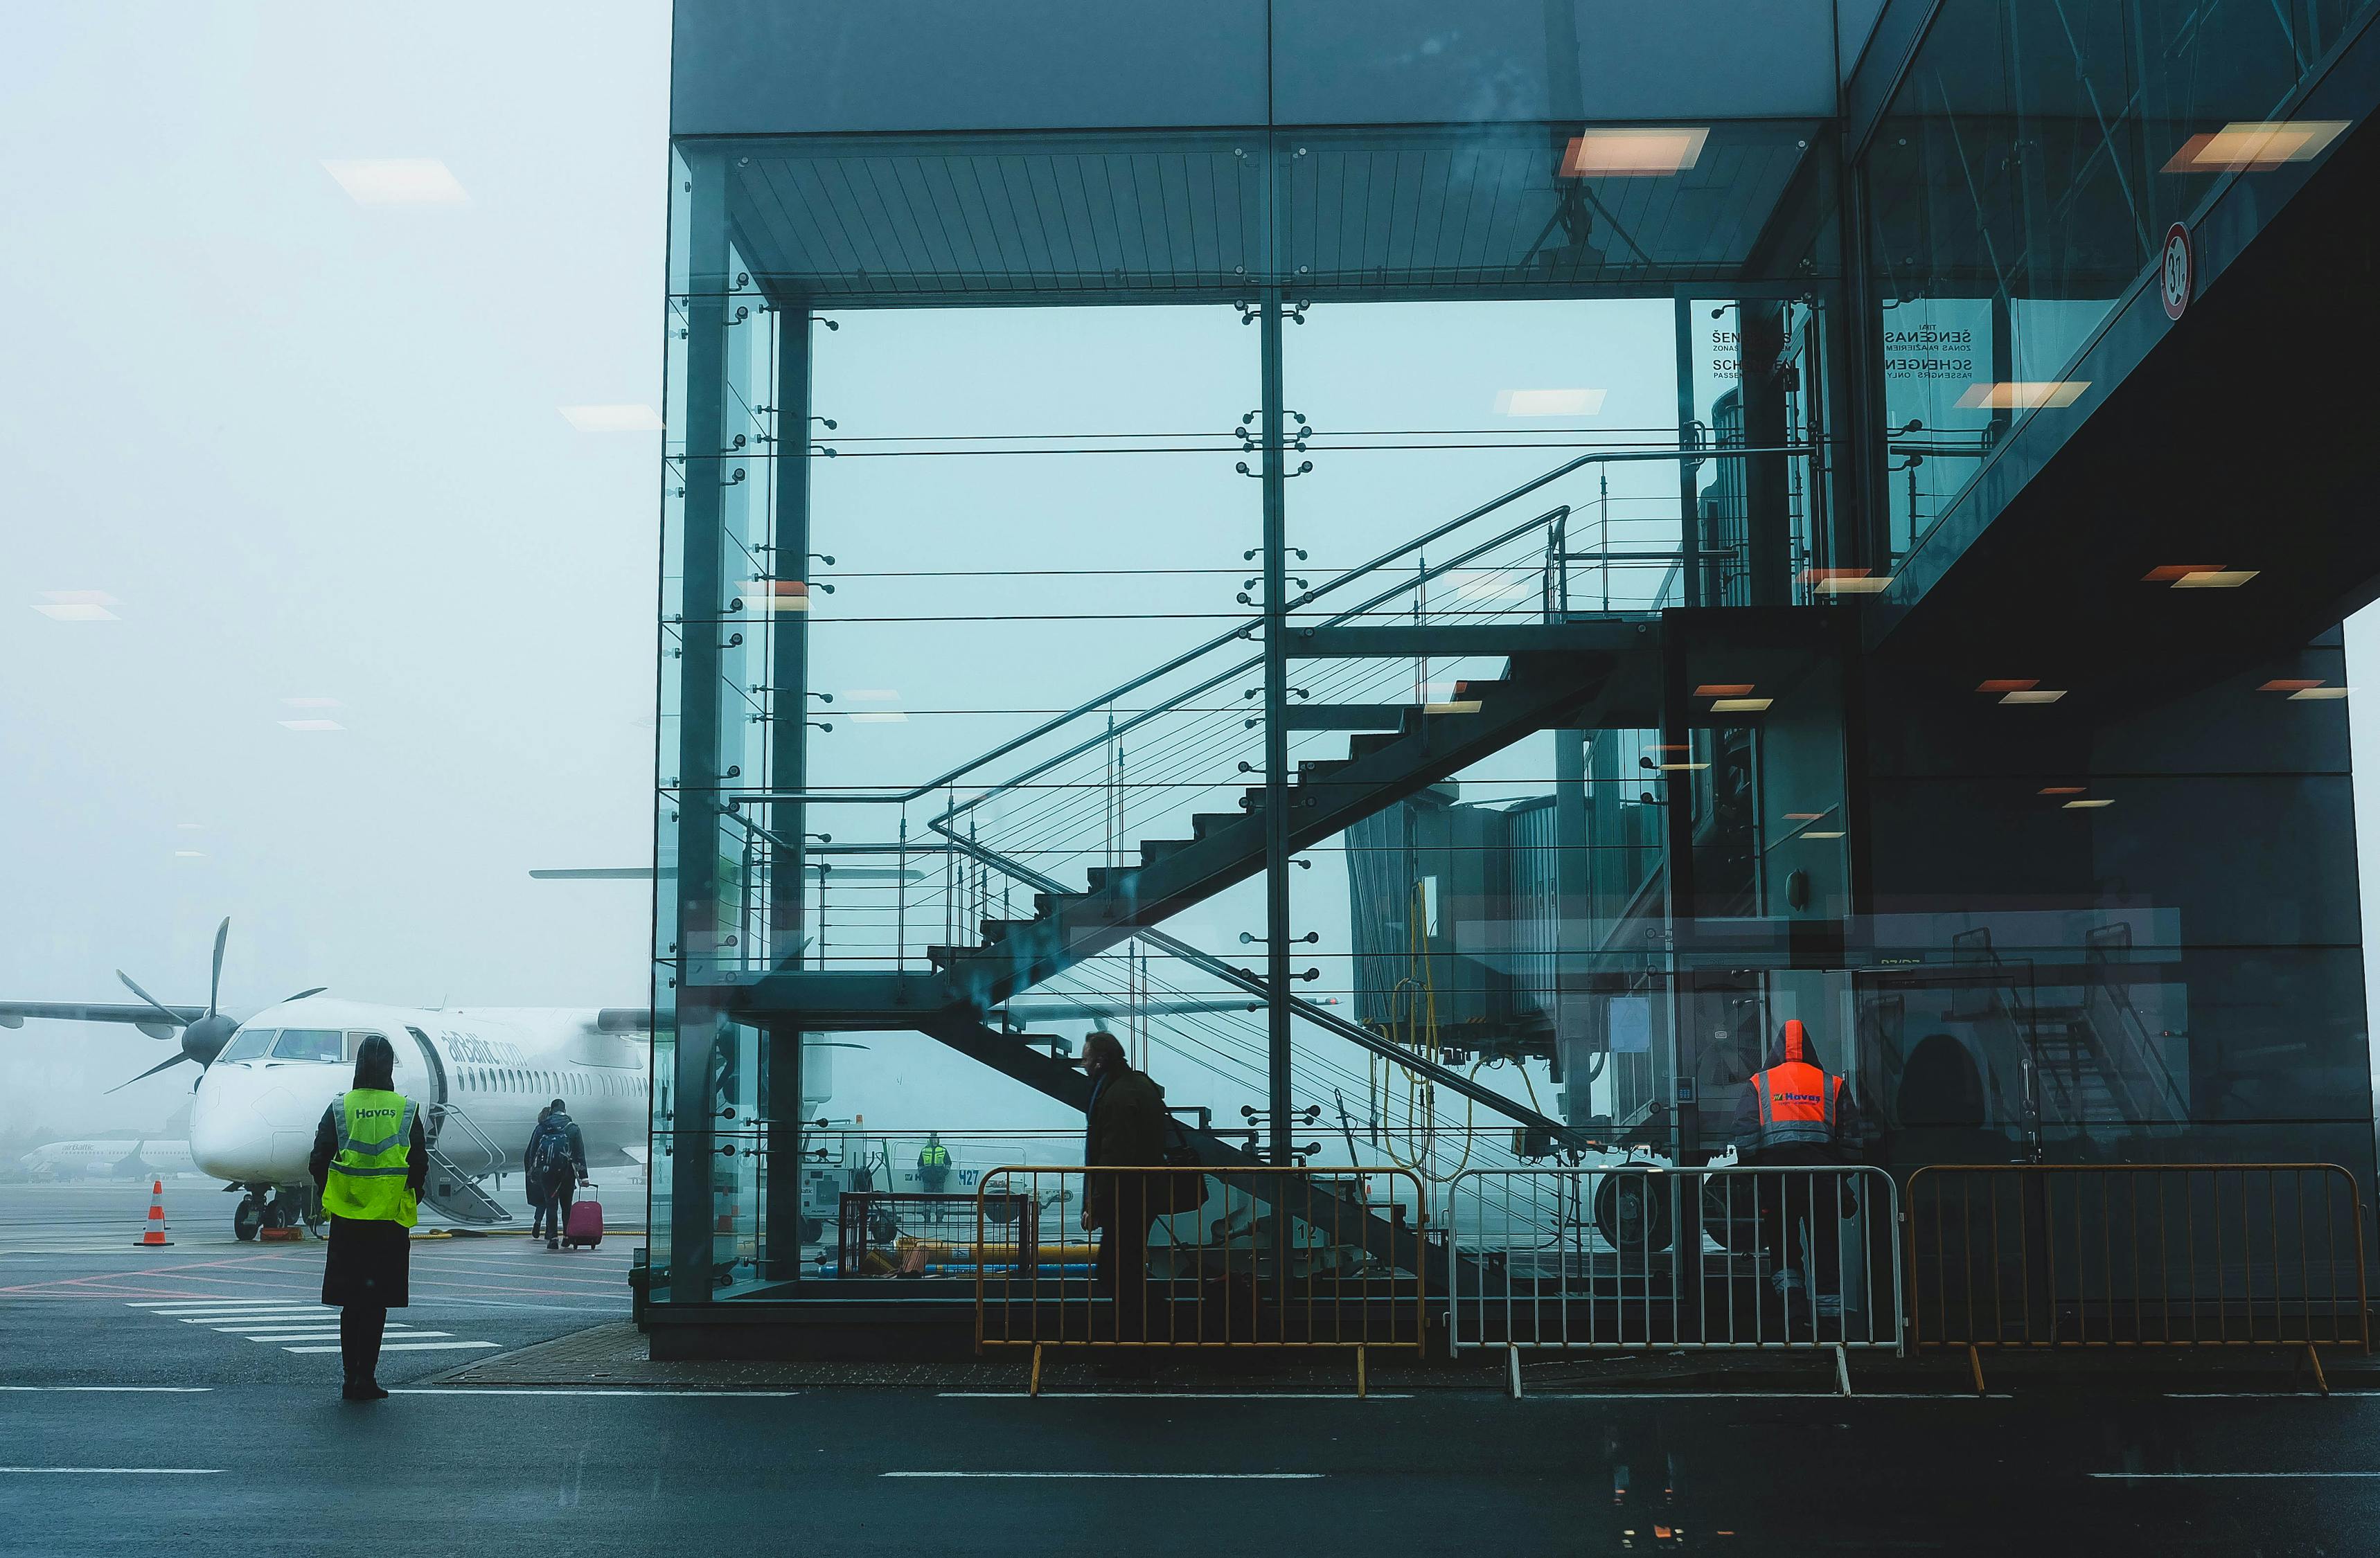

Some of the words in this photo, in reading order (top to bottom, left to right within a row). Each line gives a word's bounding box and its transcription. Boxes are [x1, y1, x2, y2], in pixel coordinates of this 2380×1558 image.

[1785, 1093, 1820, 1104] Havaş
[355, 1108, 396, 1119] Havaş
[1297, 1223, 1317, 1240] 12
